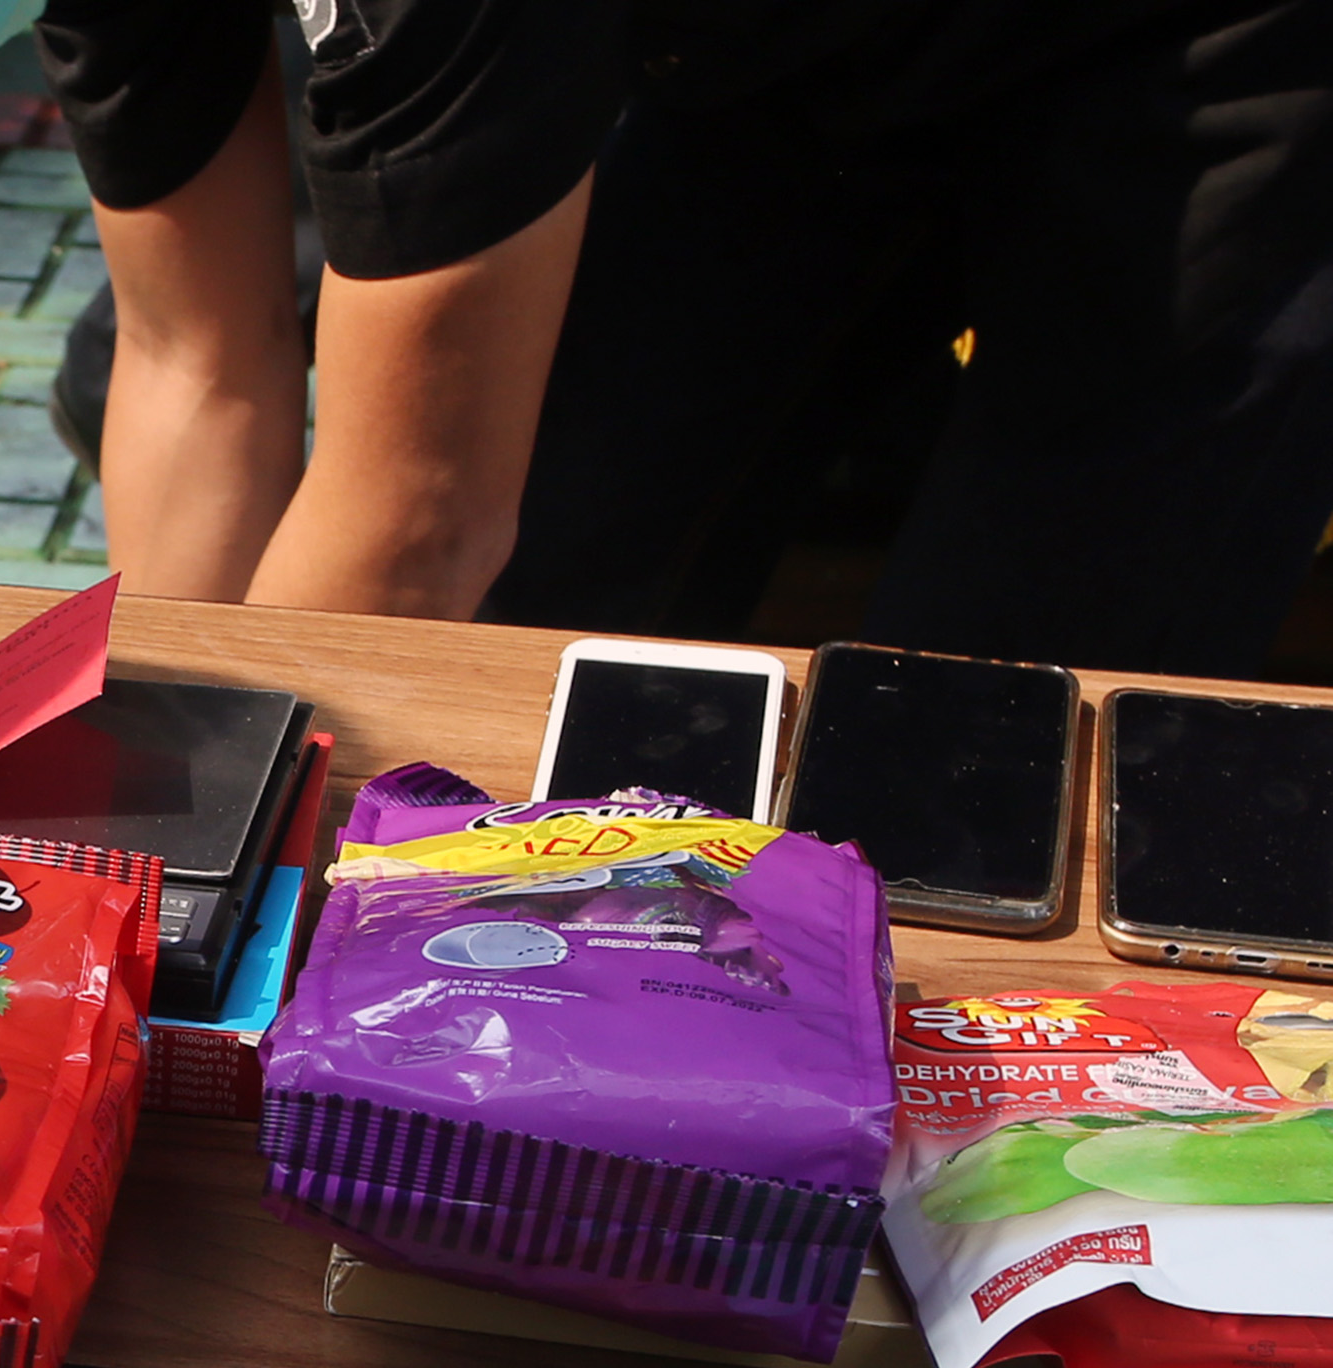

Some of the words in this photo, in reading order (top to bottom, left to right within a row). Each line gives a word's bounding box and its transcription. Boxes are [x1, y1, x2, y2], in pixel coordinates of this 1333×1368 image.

[908, 1006, 1079, 1033] SUN
[942, 1026, 1131, 1048] GIFT
[895, 1064, 1079, 1083] DEHYDRATE
[898, 1084, 1064, 1107] Dried
